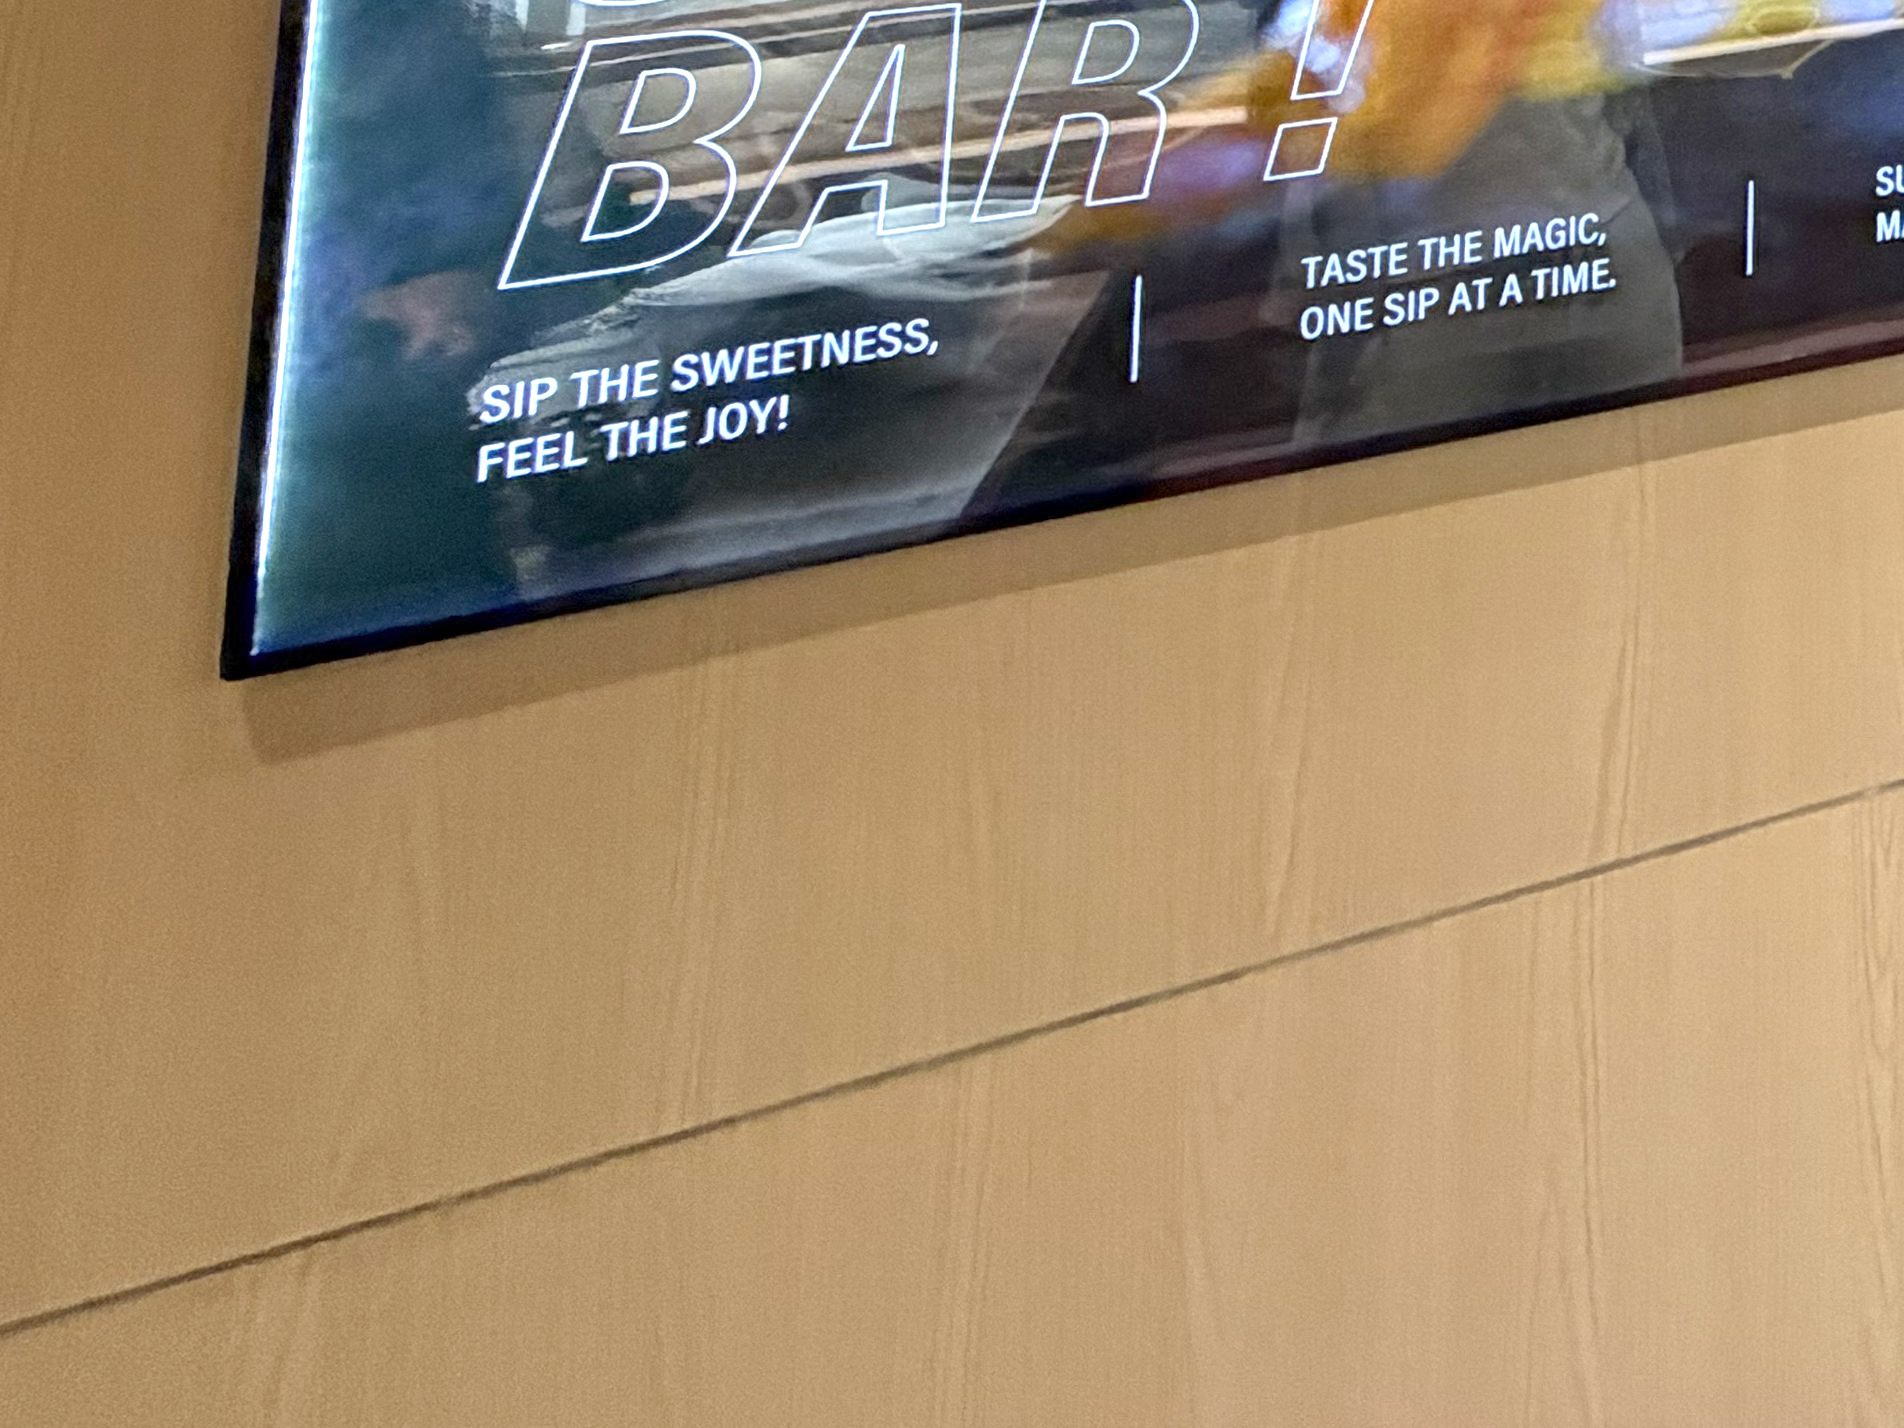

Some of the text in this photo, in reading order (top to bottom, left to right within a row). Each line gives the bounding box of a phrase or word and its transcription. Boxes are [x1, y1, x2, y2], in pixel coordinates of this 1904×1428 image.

[1301, 212, 1607, 289] TASTE THE MAGIC,
[1300, 258, 1617, 341] ONE SIP AT A TIME.
[479, 318, 939, 425] SIP THE SWEETNESS,
[476, 394, 790, 484] FEEL THE JOY!
